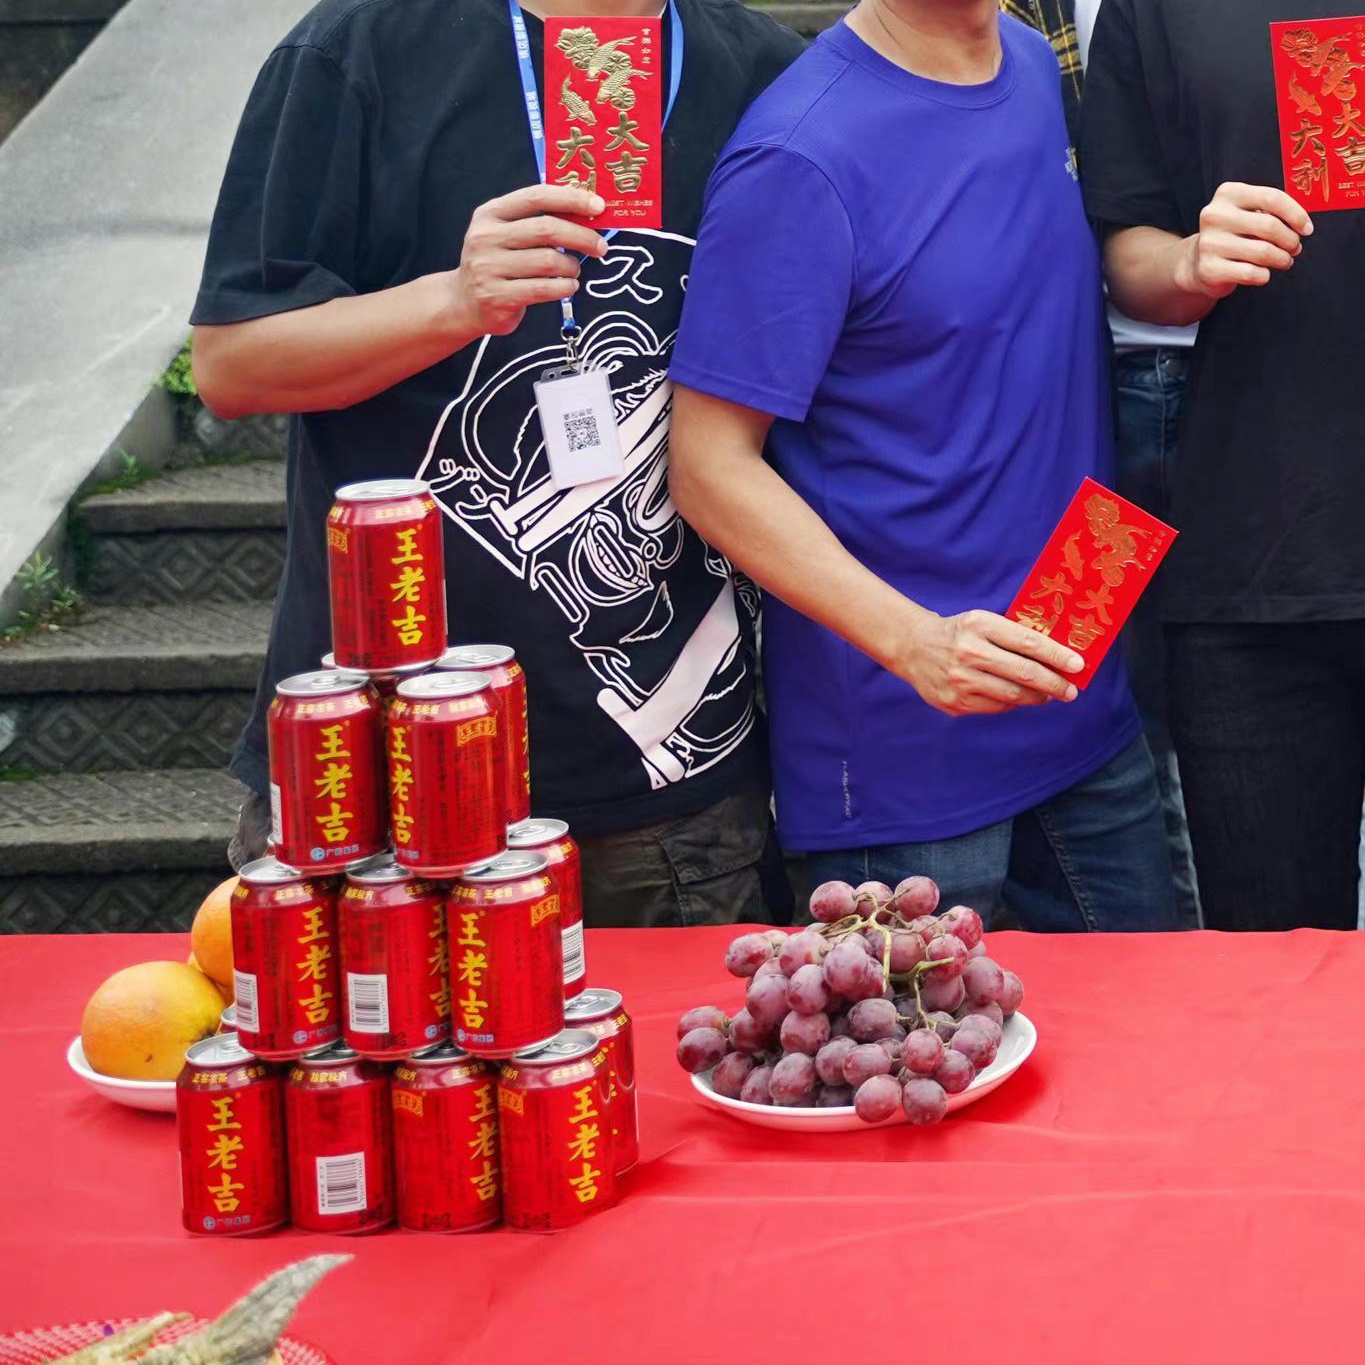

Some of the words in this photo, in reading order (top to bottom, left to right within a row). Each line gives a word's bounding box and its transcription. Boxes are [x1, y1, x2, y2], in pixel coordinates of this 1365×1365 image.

[603, 111, 649, 194] 大吉
[1289, 119, 1330, 203] 大利
[390, 527, 427, 646] 王老吉
[1068, 584, 1115, 651] 大吉
[315, 724, 353, 843] 王老吉
[391, 725, 415, 844] 王老吉
[296, 906, 333, 1025] 王老吉
[457, 911, 489, 1029] 王老吉
[206, 1096, 245, 1213] 王老吉
[468, 1084, 499, 1201] 王老吉
[568, 1085, 601, 1203] 王老吉
